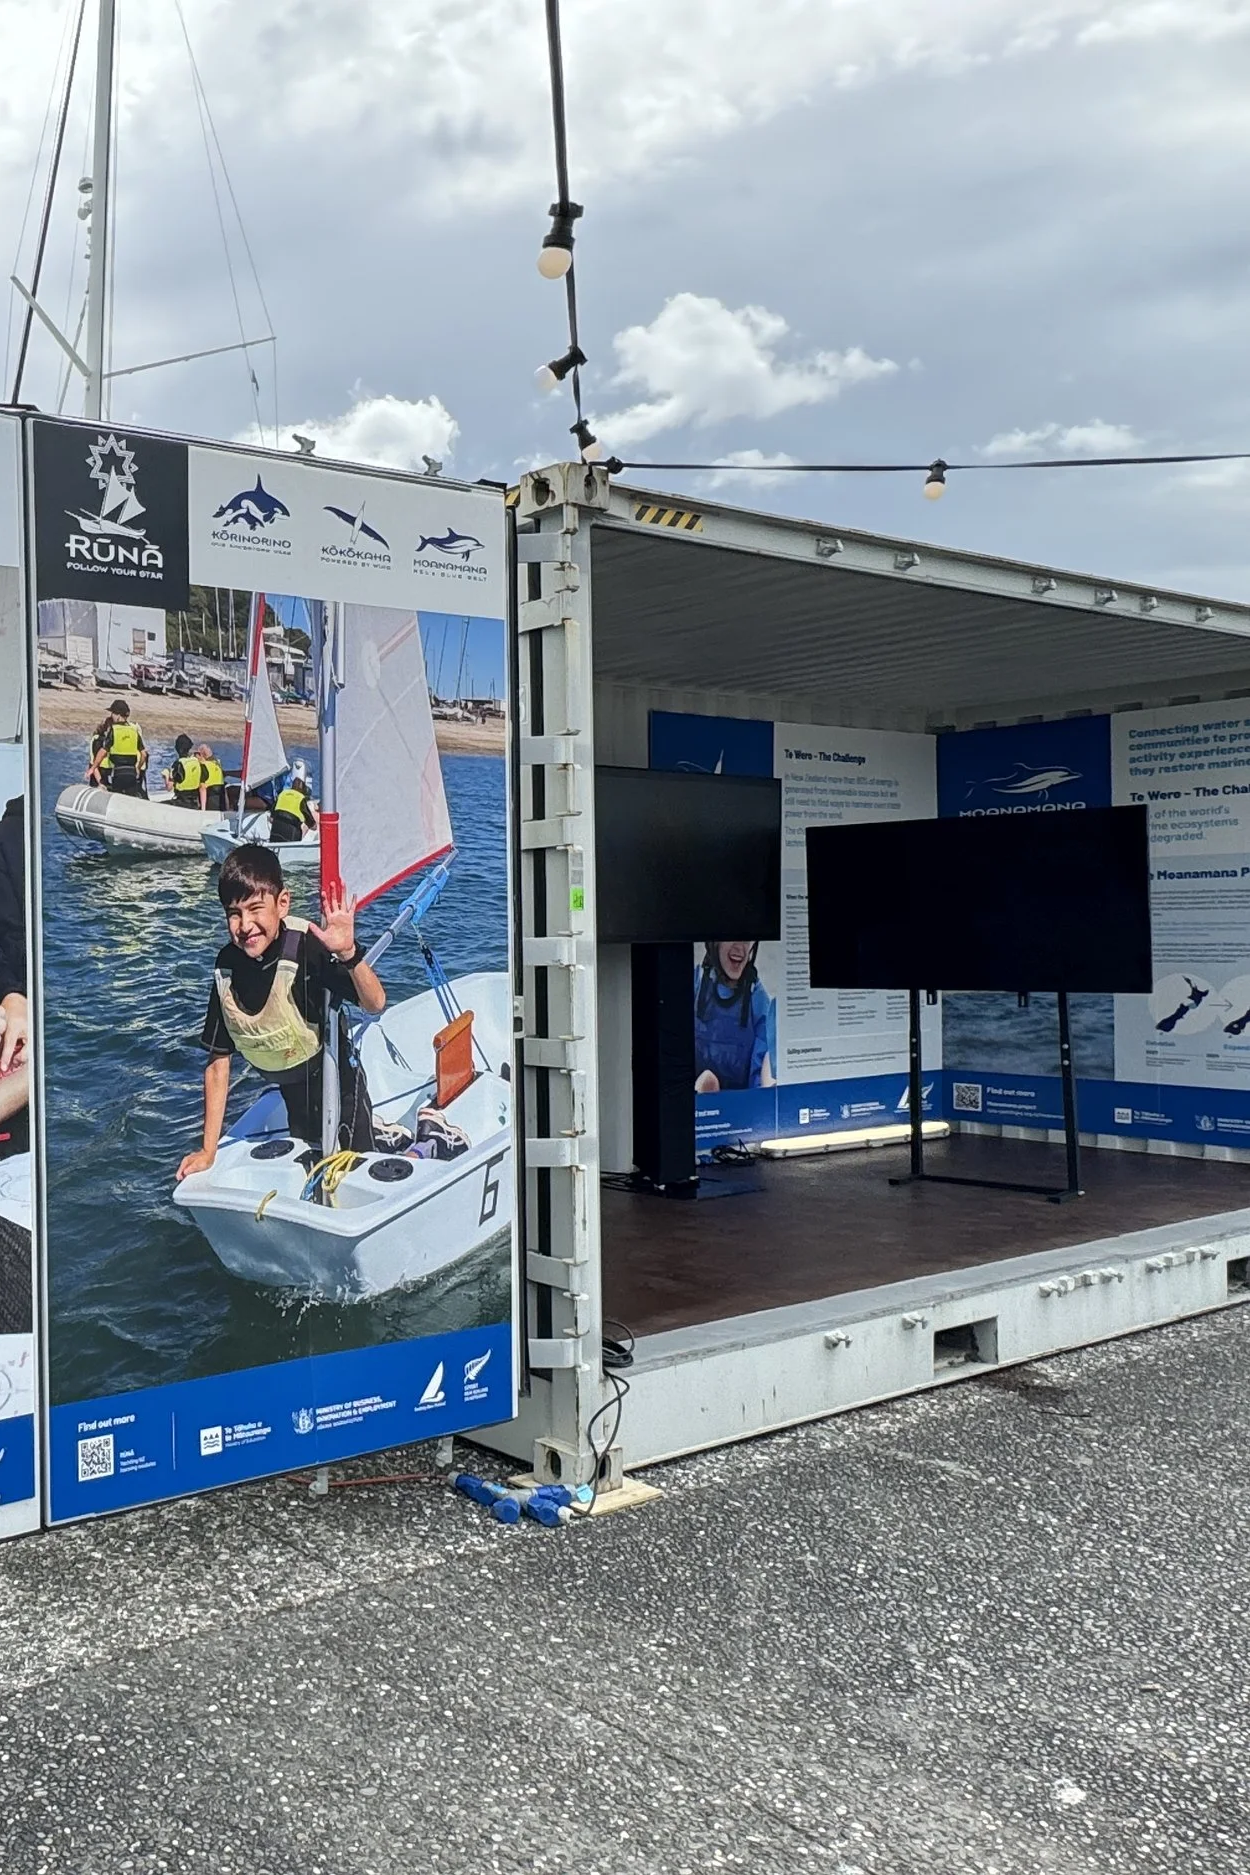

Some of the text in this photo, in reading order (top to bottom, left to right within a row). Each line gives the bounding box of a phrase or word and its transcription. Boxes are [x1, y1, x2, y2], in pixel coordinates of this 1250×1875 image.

[66, 562, 163, 580] FOLLOW YOUR STAR
[1129, 720, 1241, 738] Connecting water
[1129, 734, 1226, 751] communities to
[1129, 752, 1176, 764] activity
[1129, 766, 1155, 777] they
[1158, 762, 1206, 774] restore
[1129, 792, 1145, 802] Te
[1147, 790, 1182, 801] Wero
[1193, 786, 1219, 797] The
[1154, 804, 1231, 819] of the world's
[1170, 818, 1239, 830] ecosystems
[1156, 869, 1238, 880] Moanamana
[78, 1414, 136, 1433] Find out more
